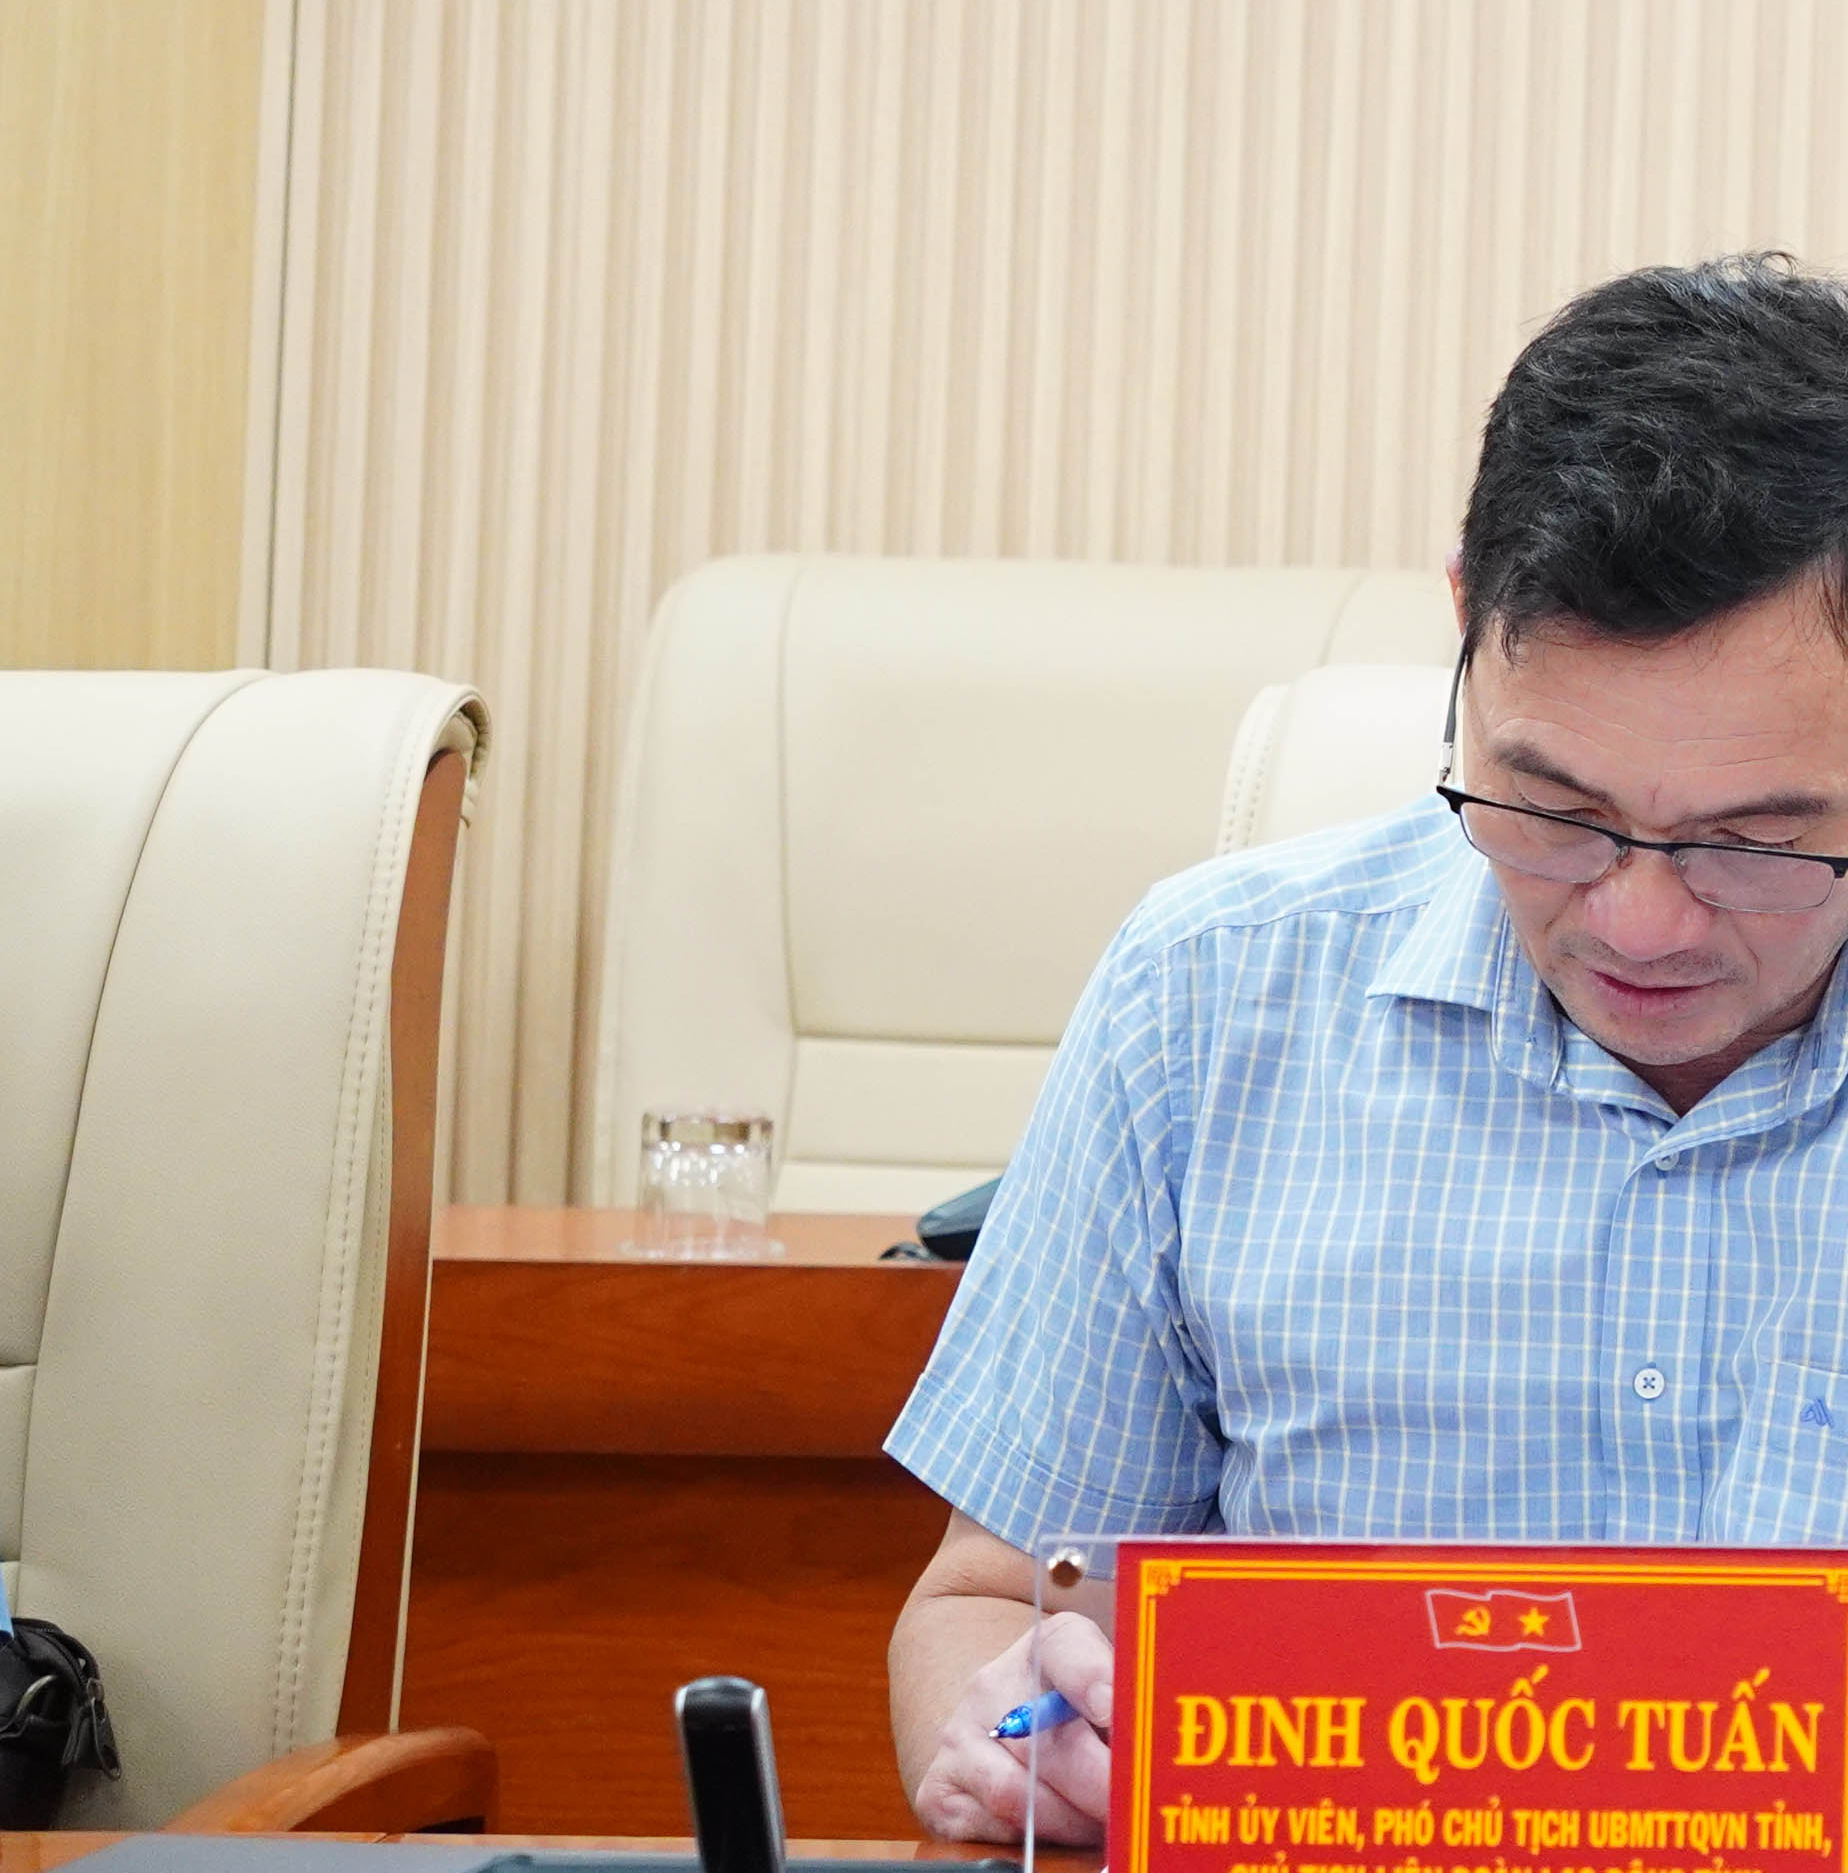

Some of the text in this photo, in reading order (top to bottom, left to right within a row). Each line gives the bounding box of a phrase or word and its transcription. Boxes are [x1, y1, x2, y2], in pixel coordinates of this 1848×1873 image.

[1176, 1666, 1823, 1784] ĐINH QUỐC TUẤN
[1162, 1794, 1831, 1855] TỈNH ỦY VIÊN, PHÓ CHỦ TỊCH UBMTTQVN TỈNH,
